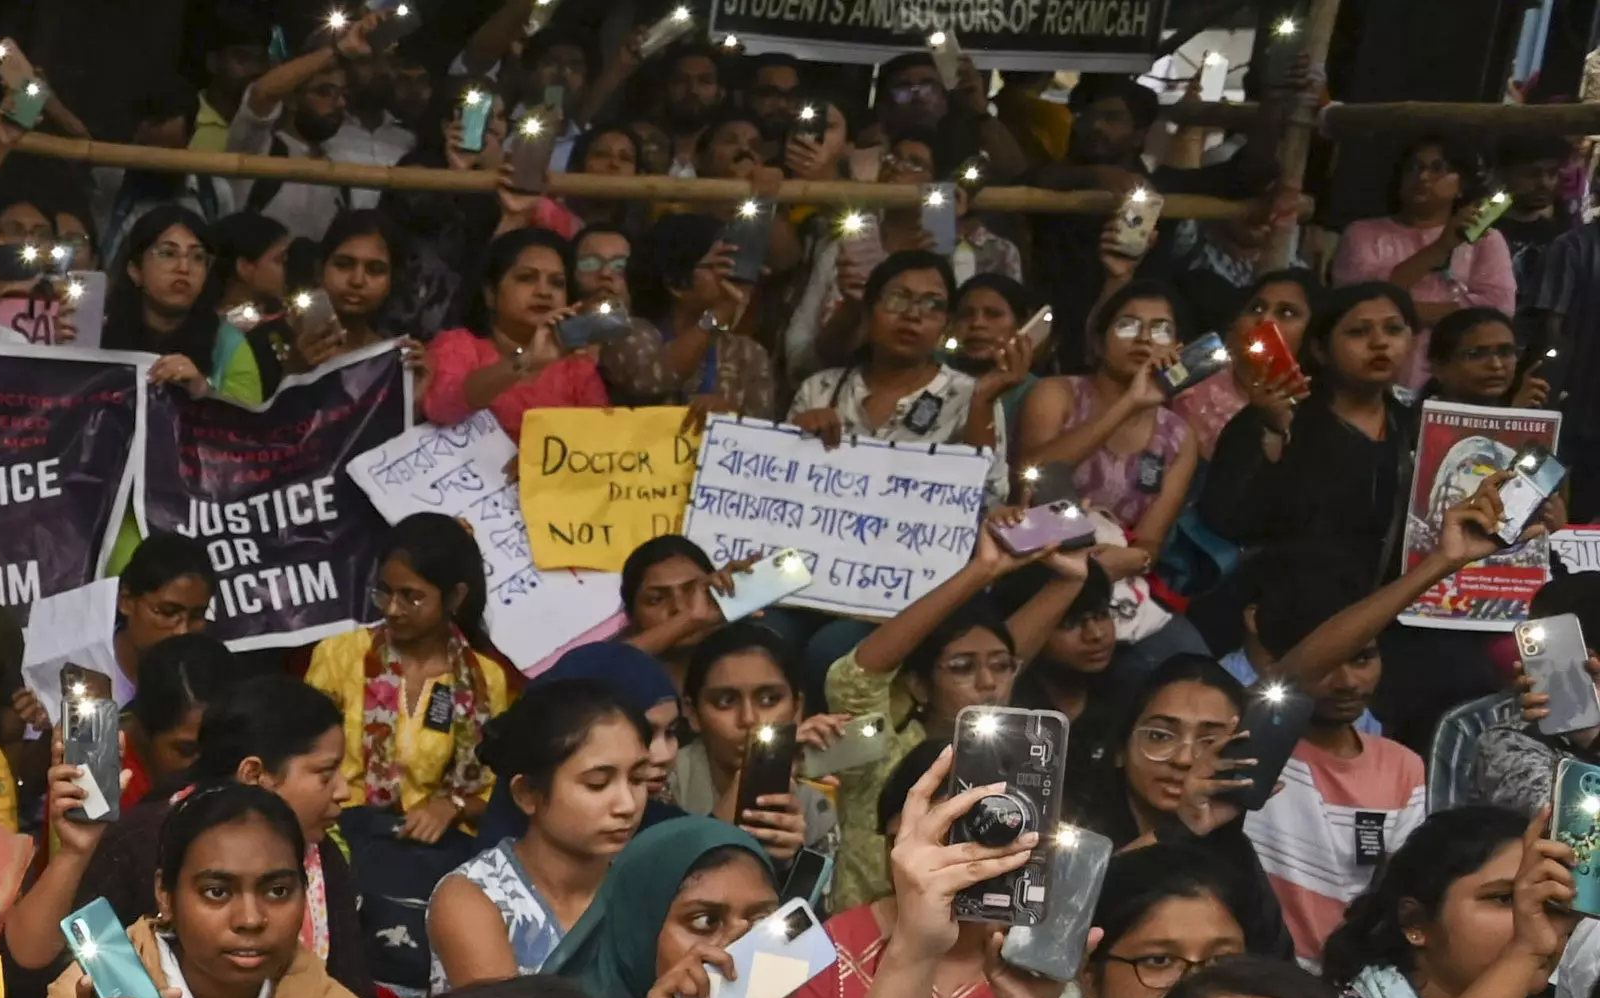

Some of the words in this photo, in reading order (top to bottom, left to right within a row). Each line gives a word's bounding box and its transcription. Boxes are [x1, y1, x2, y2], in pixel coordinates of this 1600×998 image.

[1504, 420, 1547, 434] COLLEGE
[542, 436, 654, 476] DOCTOR
[176, 474, 339, 540] JUSTICE
[549, 523, 614, 545] NOT
[206, 538, 262, 573] OR
